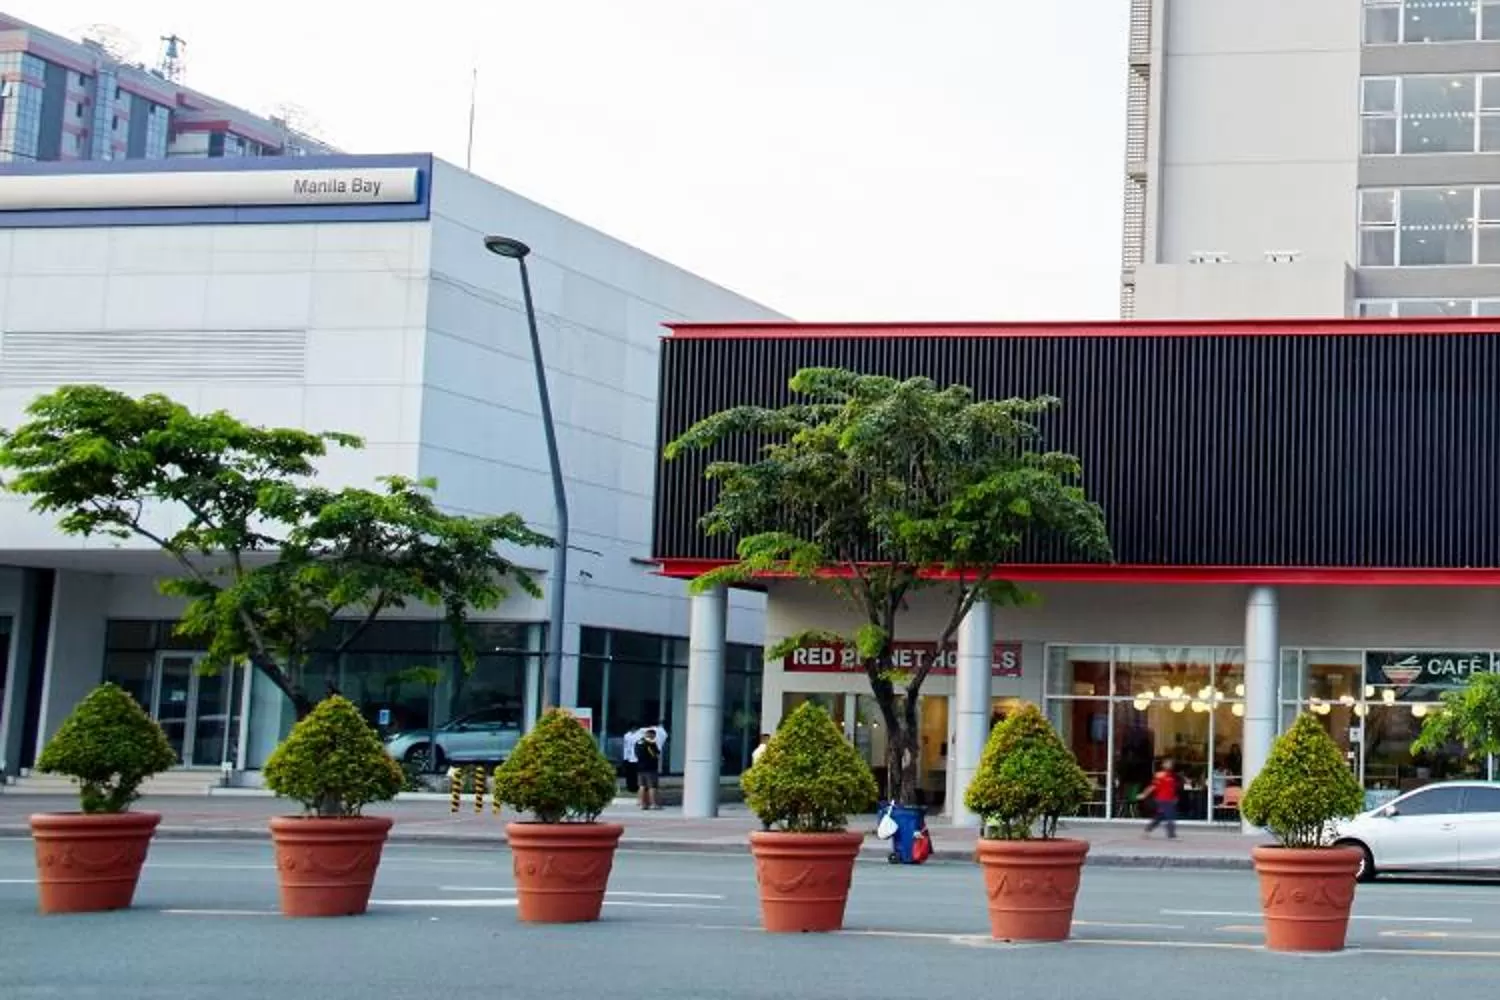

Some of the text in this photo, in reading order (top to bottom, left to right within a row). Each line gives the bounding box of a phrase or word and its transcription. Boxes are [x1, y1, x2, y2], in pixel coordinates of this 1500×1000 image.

[294, 178, 381, 197] Manila Bay
[793, 648, 1016, 670] RED PNET HOS
